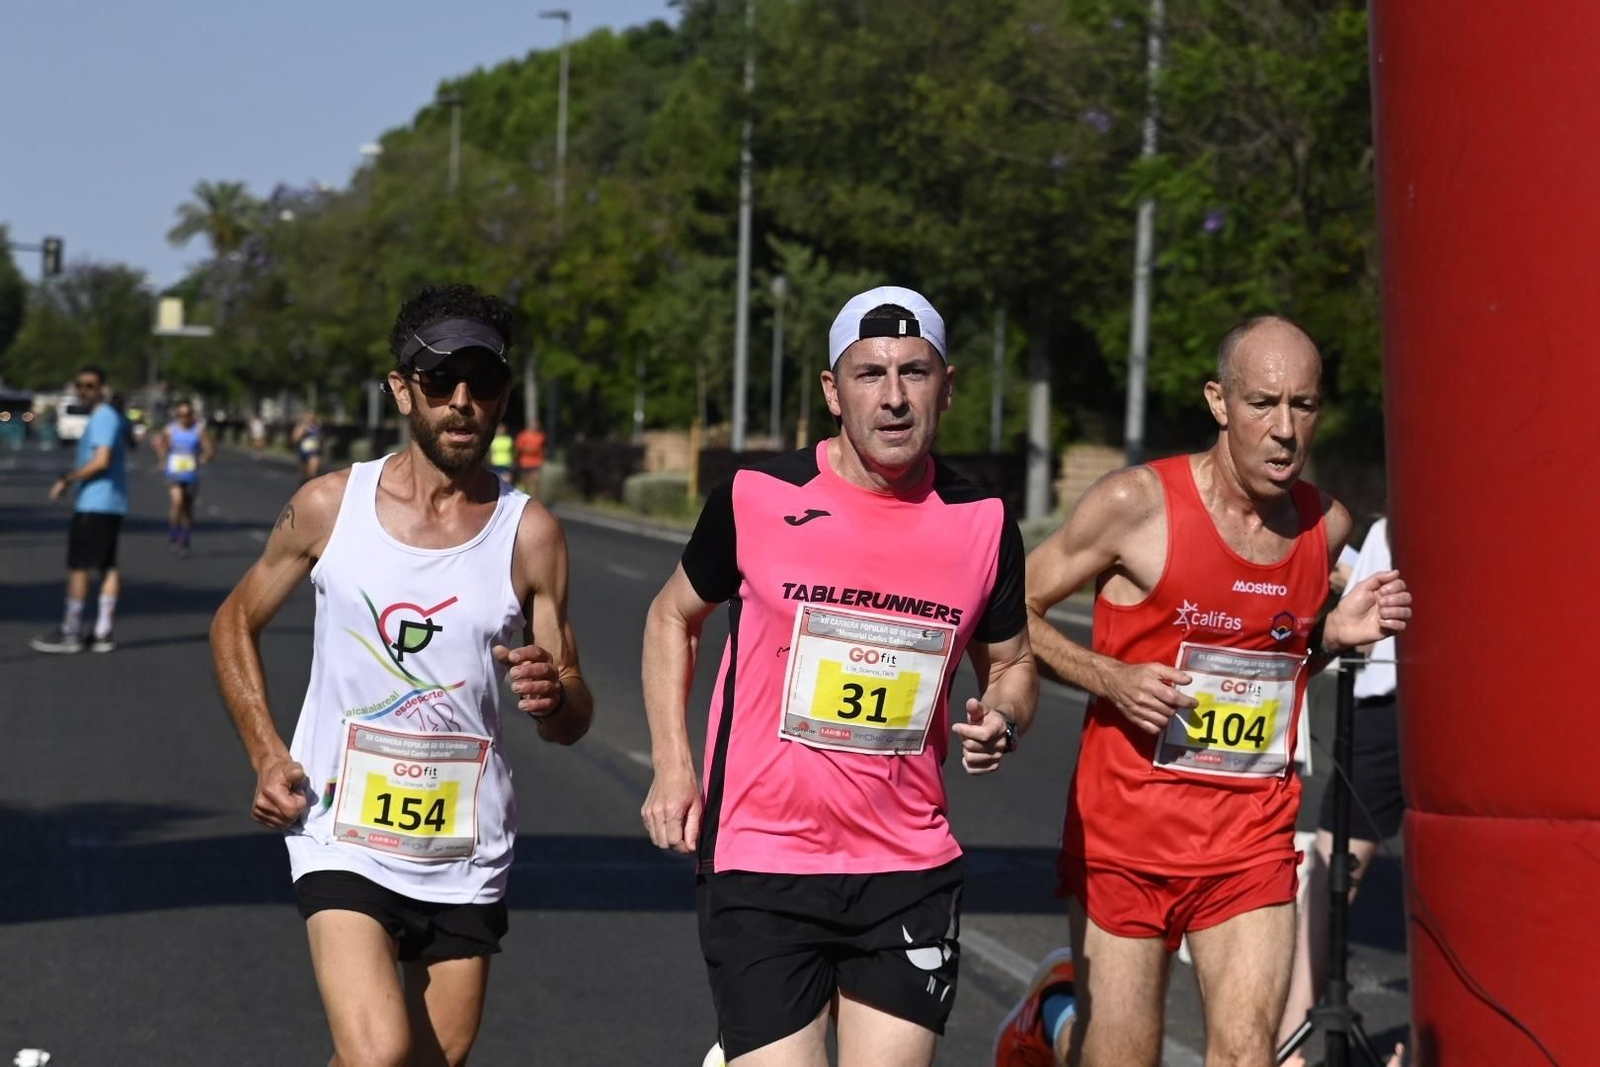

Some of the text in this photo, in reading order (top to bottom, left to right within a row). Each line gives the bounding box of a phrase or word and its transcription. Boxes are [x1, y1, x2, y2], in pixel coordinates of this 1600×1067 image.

[782, 582, 963, 626] TABLERUNNERS
[1232, 580, 1287, 596] Mosttro
[830, 618, 859, 630] CARRERA
[860, 623, 888, 634] POPULAR
[1191, 610, 1242, 630] califas
[395, 690, 444, 717] esdeporte
[837, 683, 888, 724] 31
[1198, 710, 1266, 748] 104
[373, 792, 446, 832] 154
